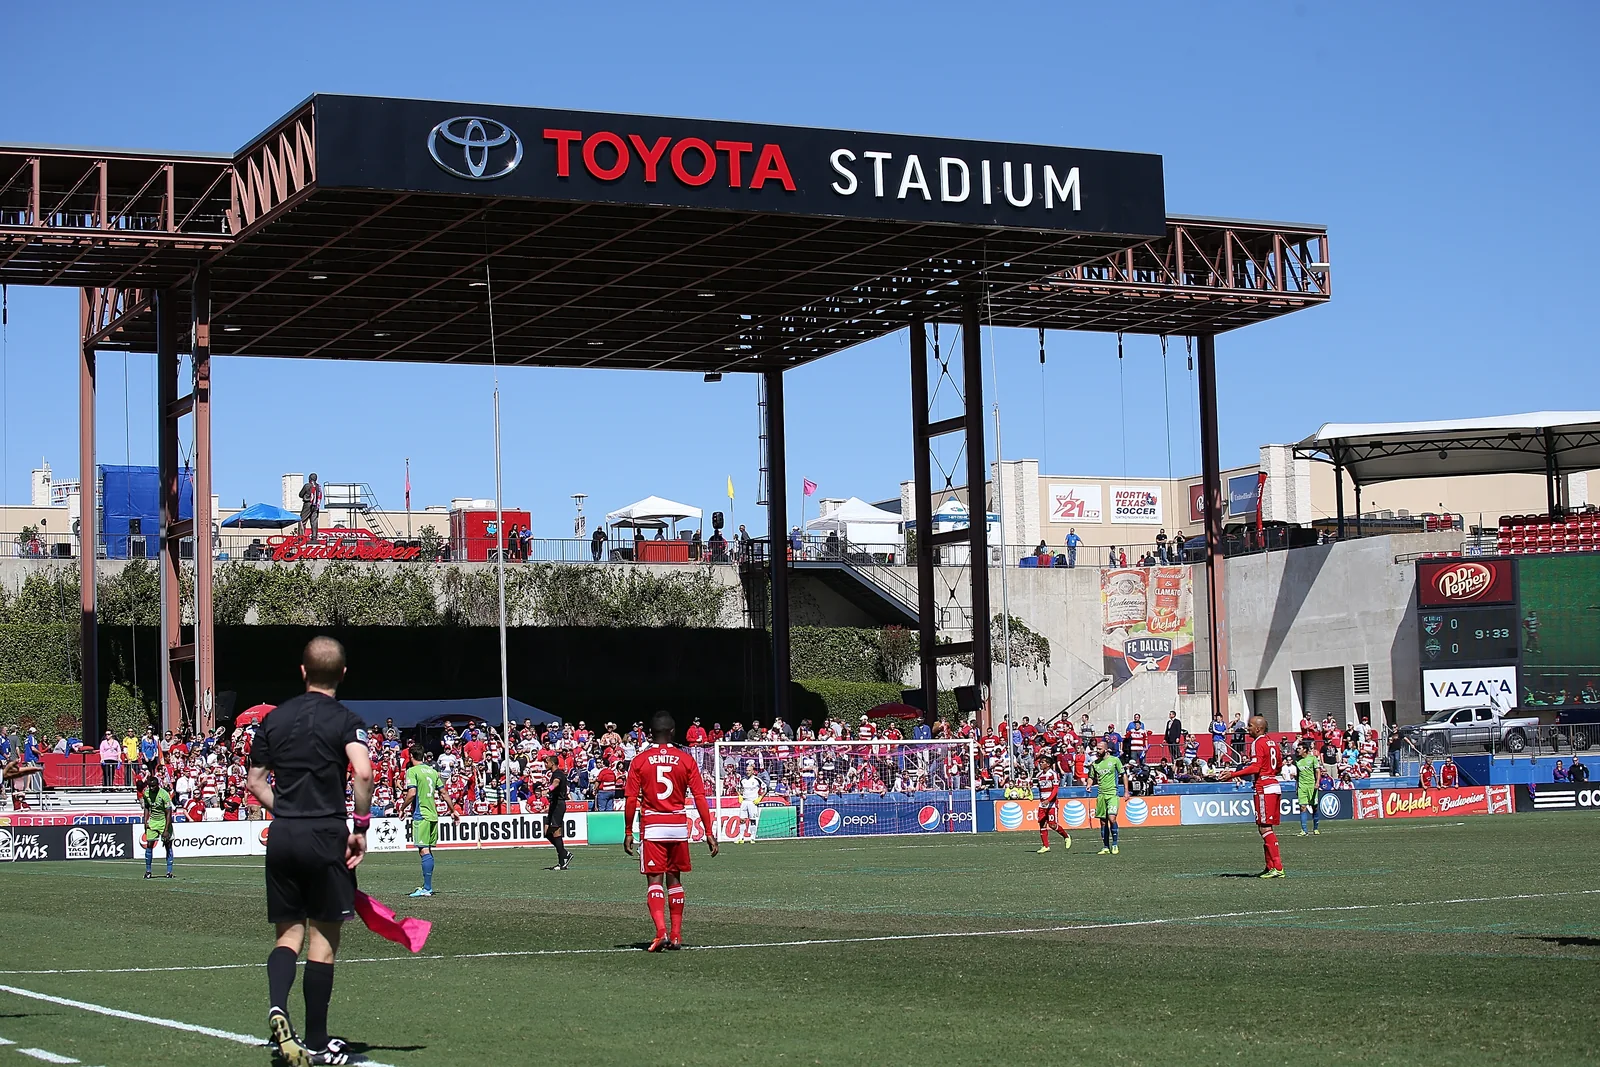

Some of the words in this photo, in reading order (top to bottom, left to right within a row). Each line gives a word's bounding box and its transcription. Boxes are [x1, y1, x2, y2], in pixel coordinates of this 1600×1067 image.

[543, 128, 797, 192] TOYOTA
[830, 148, 1082, 212] STADIUM
[1116, 491, 1148, 500] NORTH
[1061, 500, 1085, 517] 21
[1084, 510, 1099, 518] HD
[1116, 500, 1147, 508] TEXAS
[1116, 507, 1156, 515] SOCCER
[266, 535, 421, 562] Budweiser
[1457, 567, 1475, 582] Dr
[1443, 572, 1486, 597] Pepper
[1450, 619, 1458, 629] 0
[1475, 628, 1509, 639] 9:33
[1128, 642, 1137, 653] FC
[1140, 639, 1169, 652] DALLAS
[1451, 643, 1459, 654] 0
[648, 755, 679, 765] BENITEZ
[1270, 747, 1277, 770] 8
[426, 776, 433, 798] 3
[656, 765, 674, 800] 5
[1193, 799, 1313, 817] VOLKSGE
[1386, 790, 1431, 815] Chelada
[1432, 805, 1439, 813] by
[1439, 793, 1485, 812] Budweiser
[941, 811, 972, 823] peps
[1151, 803, 1175, 817] at&t
[843, 813, 877, 827] pepsi
